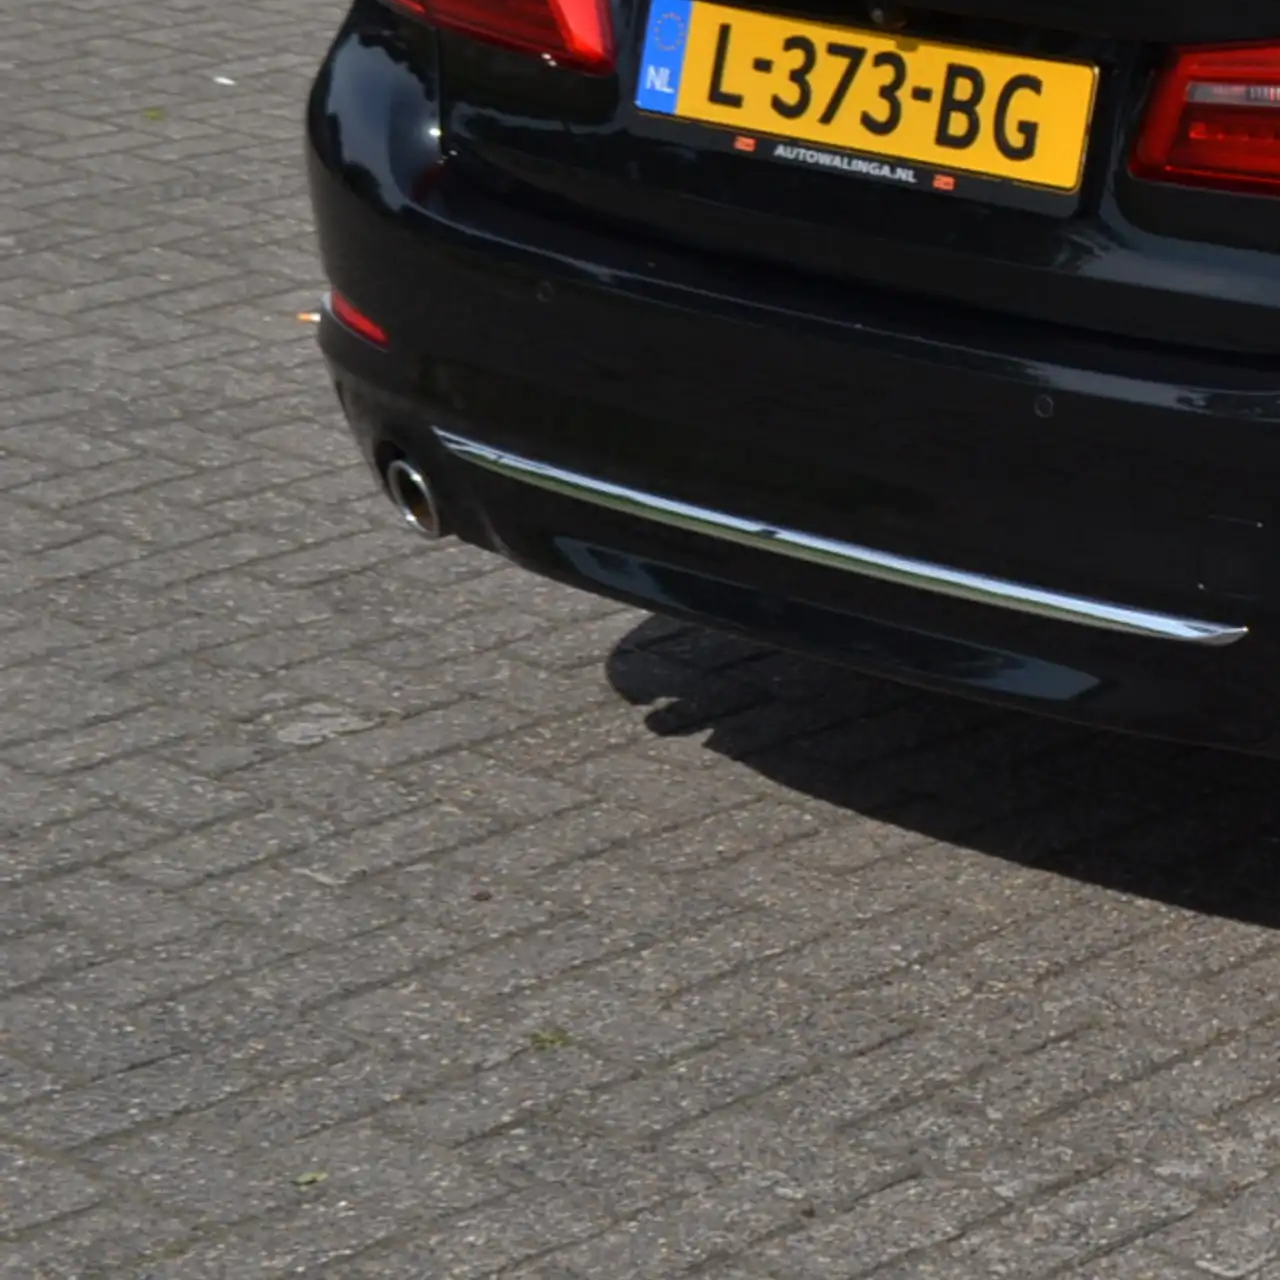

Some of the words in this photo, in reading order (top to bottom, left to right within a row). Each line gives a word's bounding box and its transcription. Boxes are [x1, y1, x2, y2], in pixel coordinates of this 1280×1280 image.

[645, 65, 675, 94] NL
[707, 23, 1044, 162] L-373-BG
[773, 143, 918, 184] AUTOWALINGA.NL
